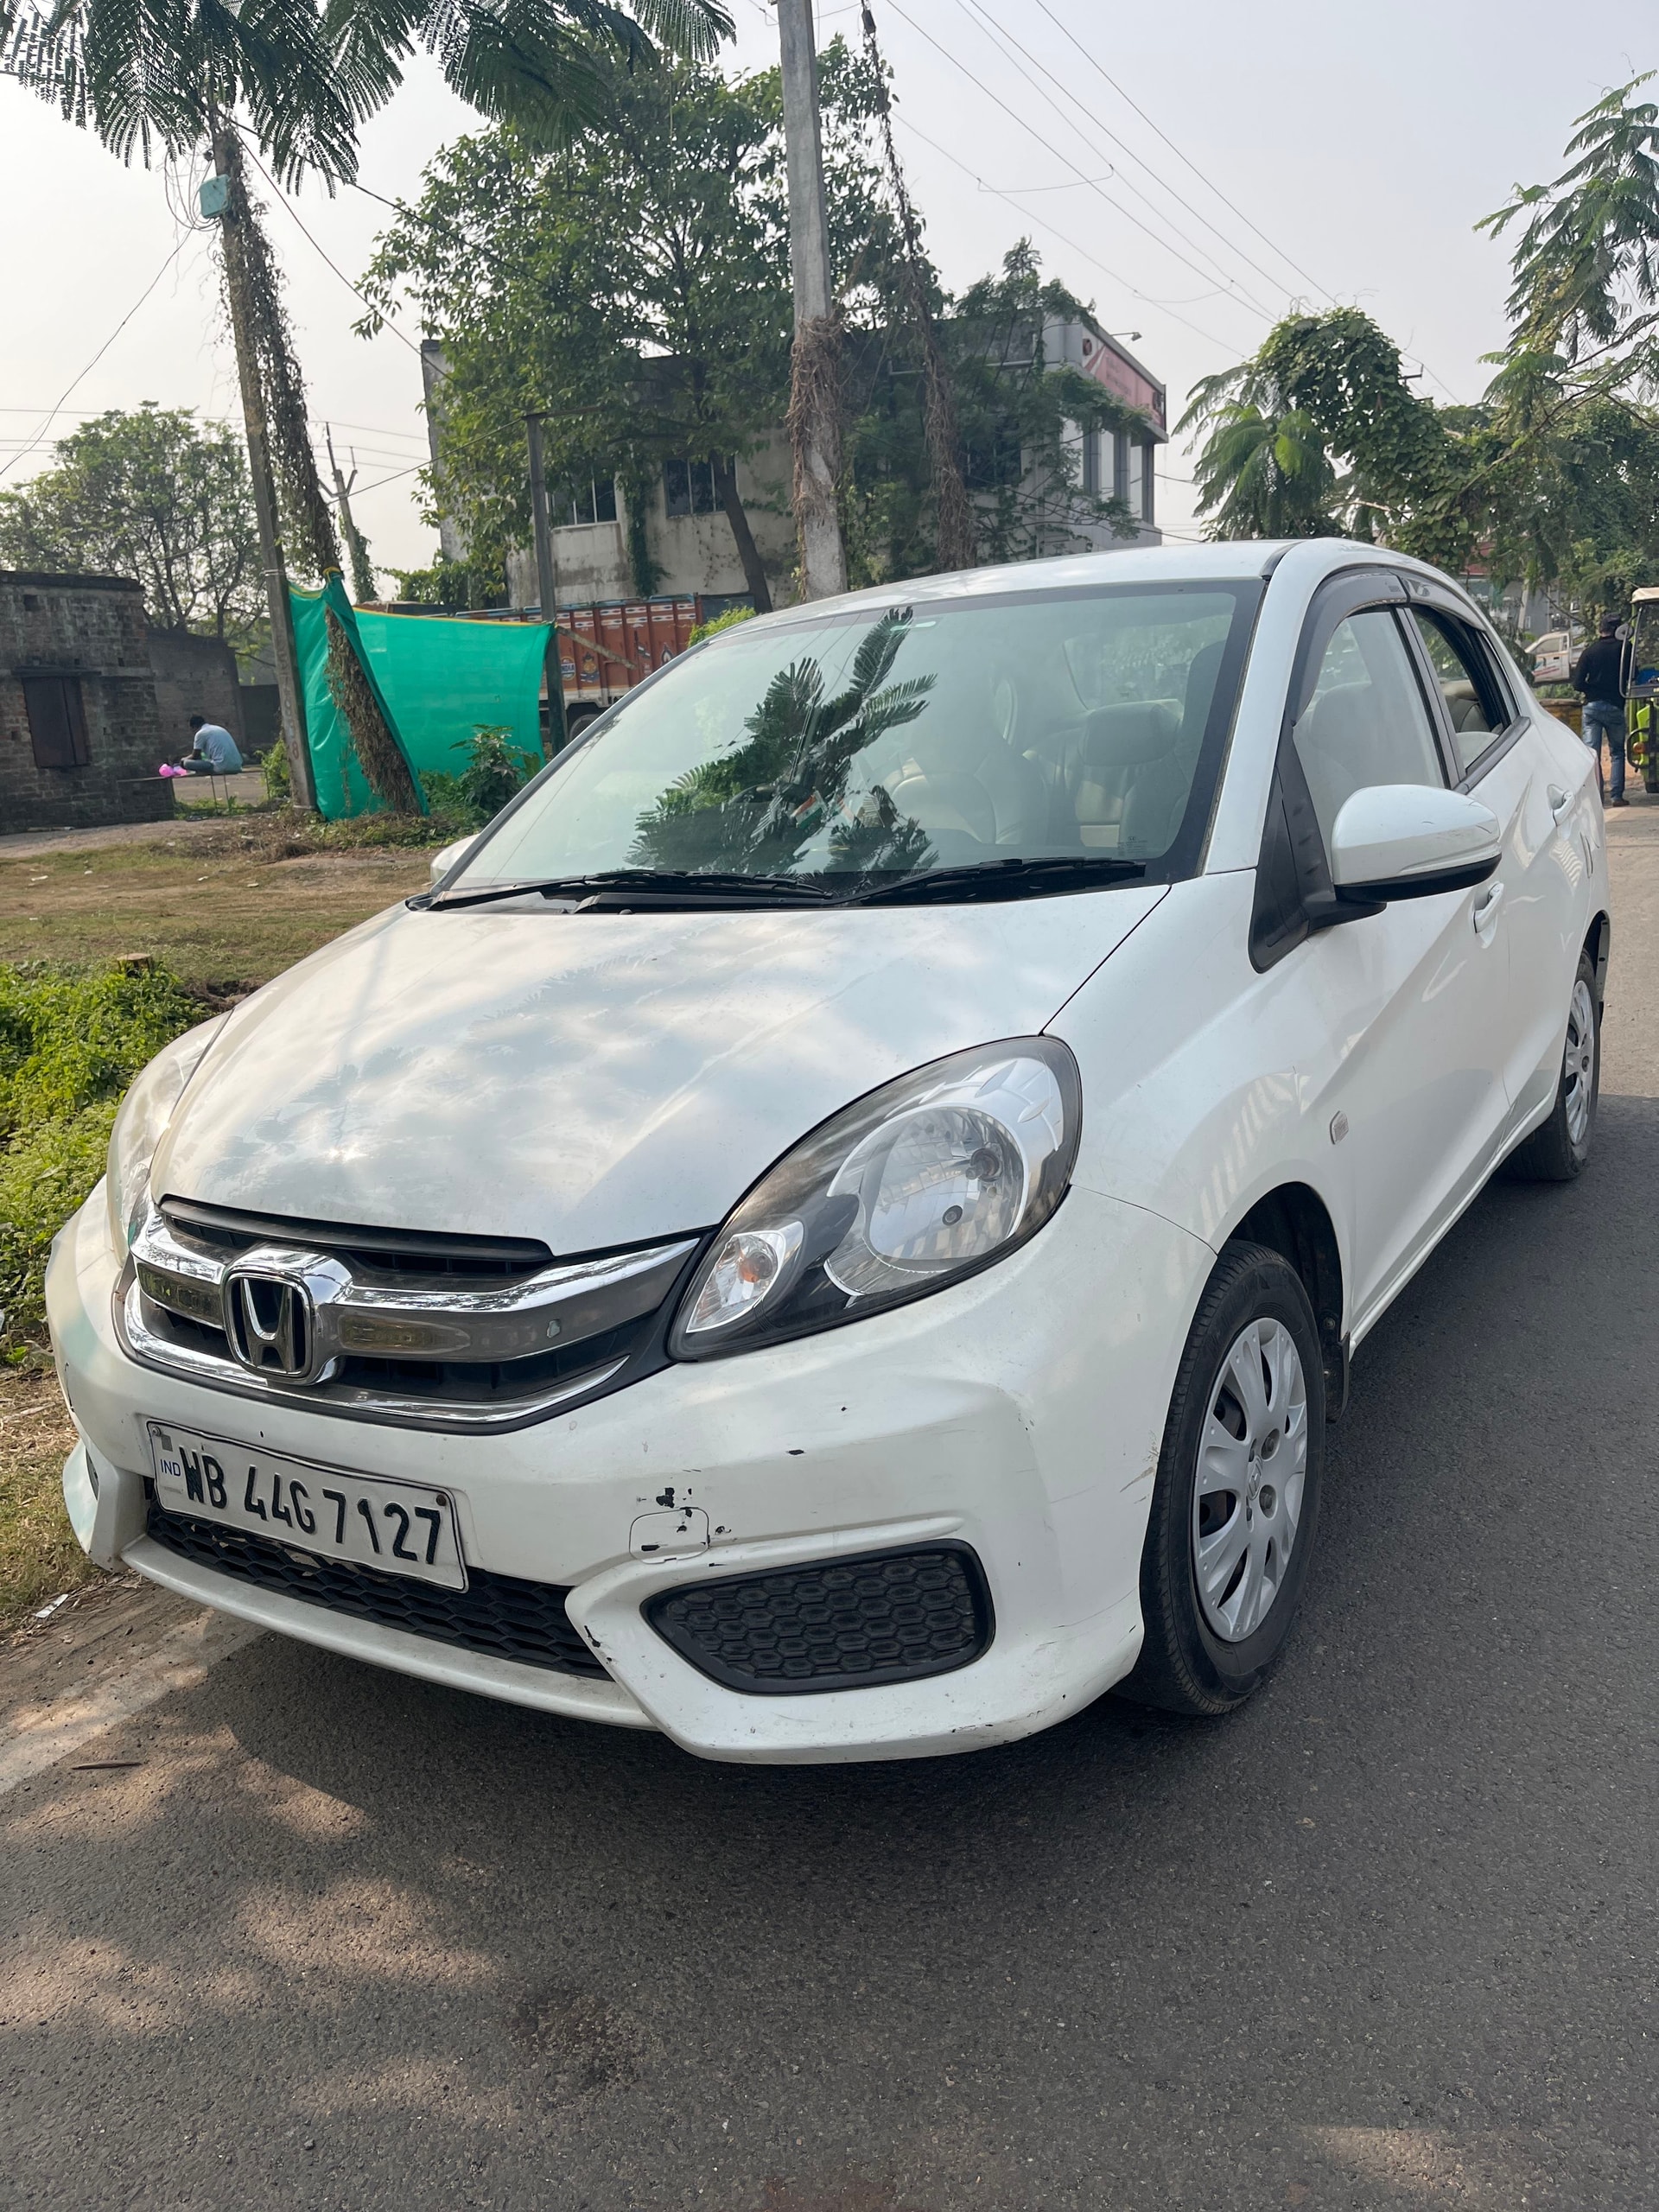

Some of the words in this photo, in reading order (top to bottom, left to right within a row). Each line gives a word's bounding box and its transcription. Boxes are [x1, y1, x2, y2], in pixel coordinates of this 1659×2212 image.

[160, 1459, 181, 1477] IND
[178, 1445, 228, 1510] WB
[321, 1487, 442, 1565] 7127
